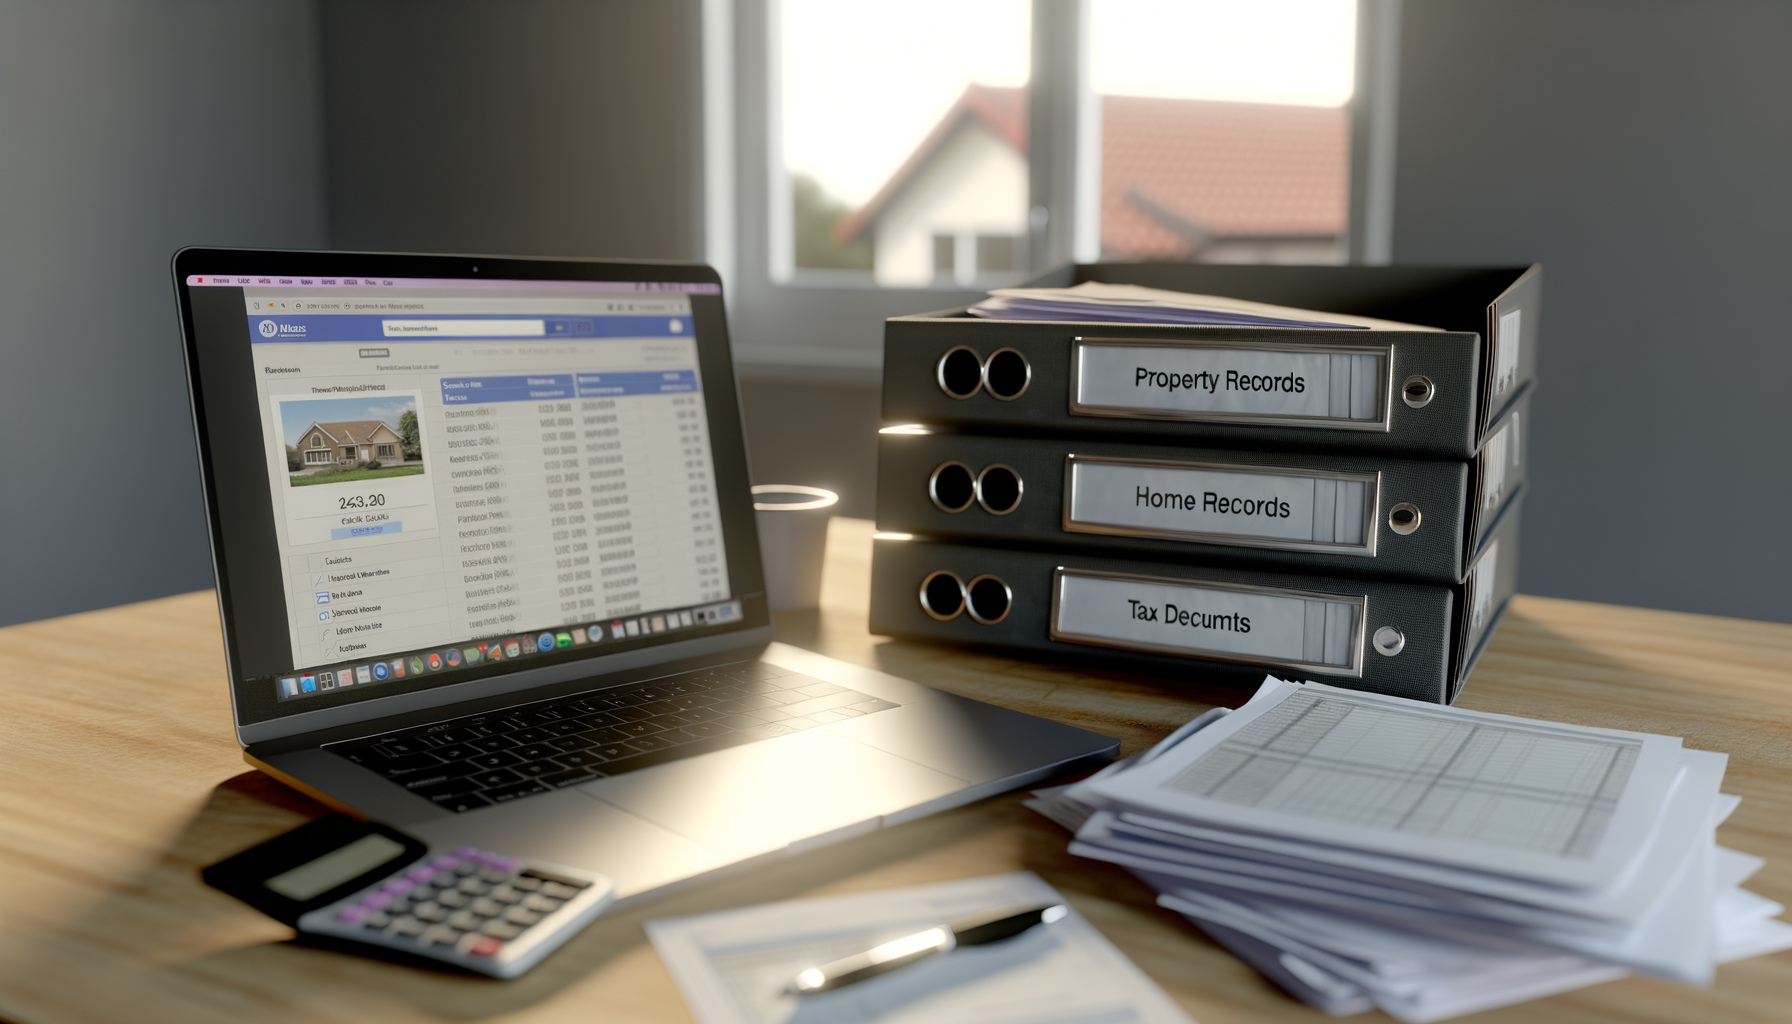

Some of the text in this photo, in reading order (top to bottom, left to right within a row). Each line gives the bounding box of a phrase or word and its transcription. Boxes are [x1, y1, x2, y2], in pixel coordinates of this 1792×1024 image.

[1135, 367, 1305, 394] Property Records
[1136, 486, 1290, 518] Home Records
[1128, 599, 1251, 633] Tax Decumts
